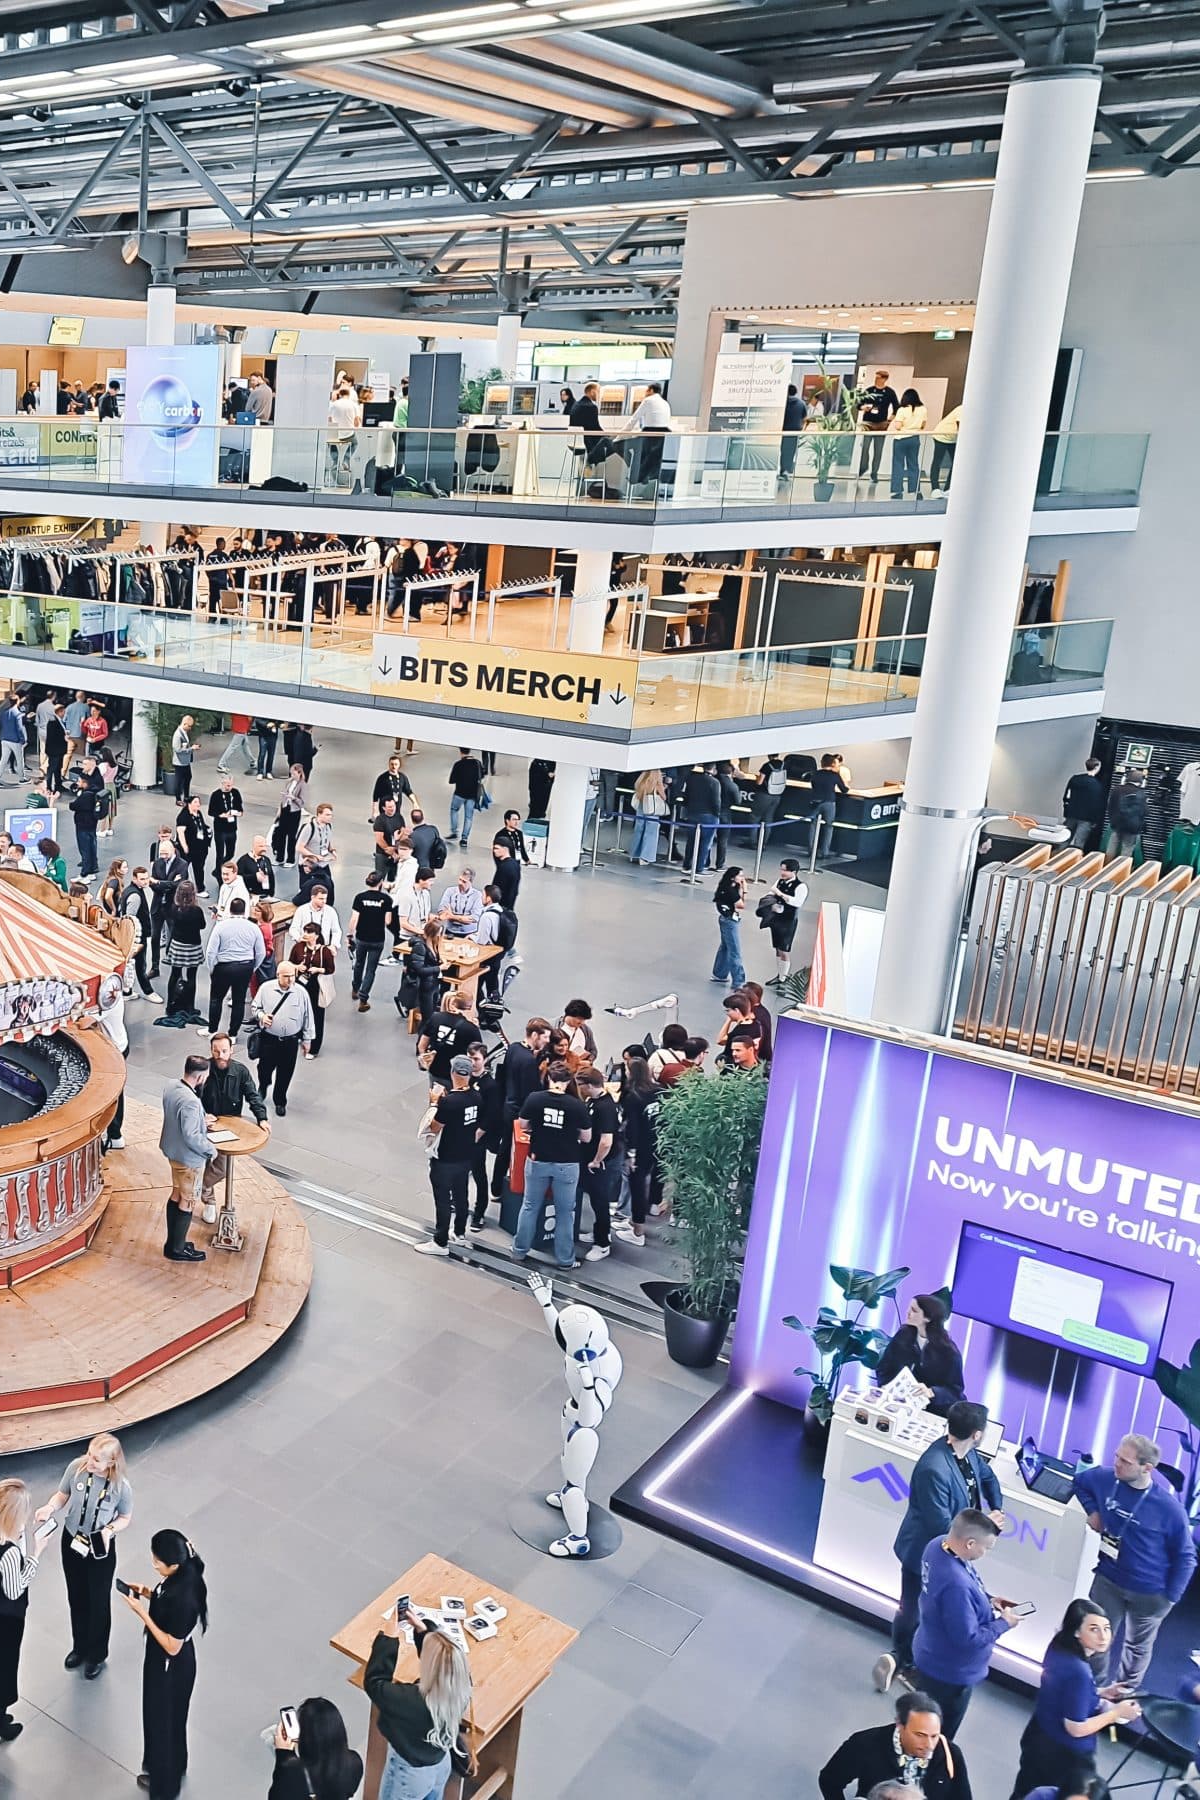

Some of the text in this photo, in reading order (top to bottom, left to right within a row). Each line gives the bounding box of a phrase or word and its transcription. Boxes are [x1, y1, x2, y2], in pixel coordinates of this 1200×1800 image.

[17, 525, 50, 535] STARTUP
[399, 655, 601, 705] BITS MERCH
[927, 1159, 1200, 1265] Now you're talkin
